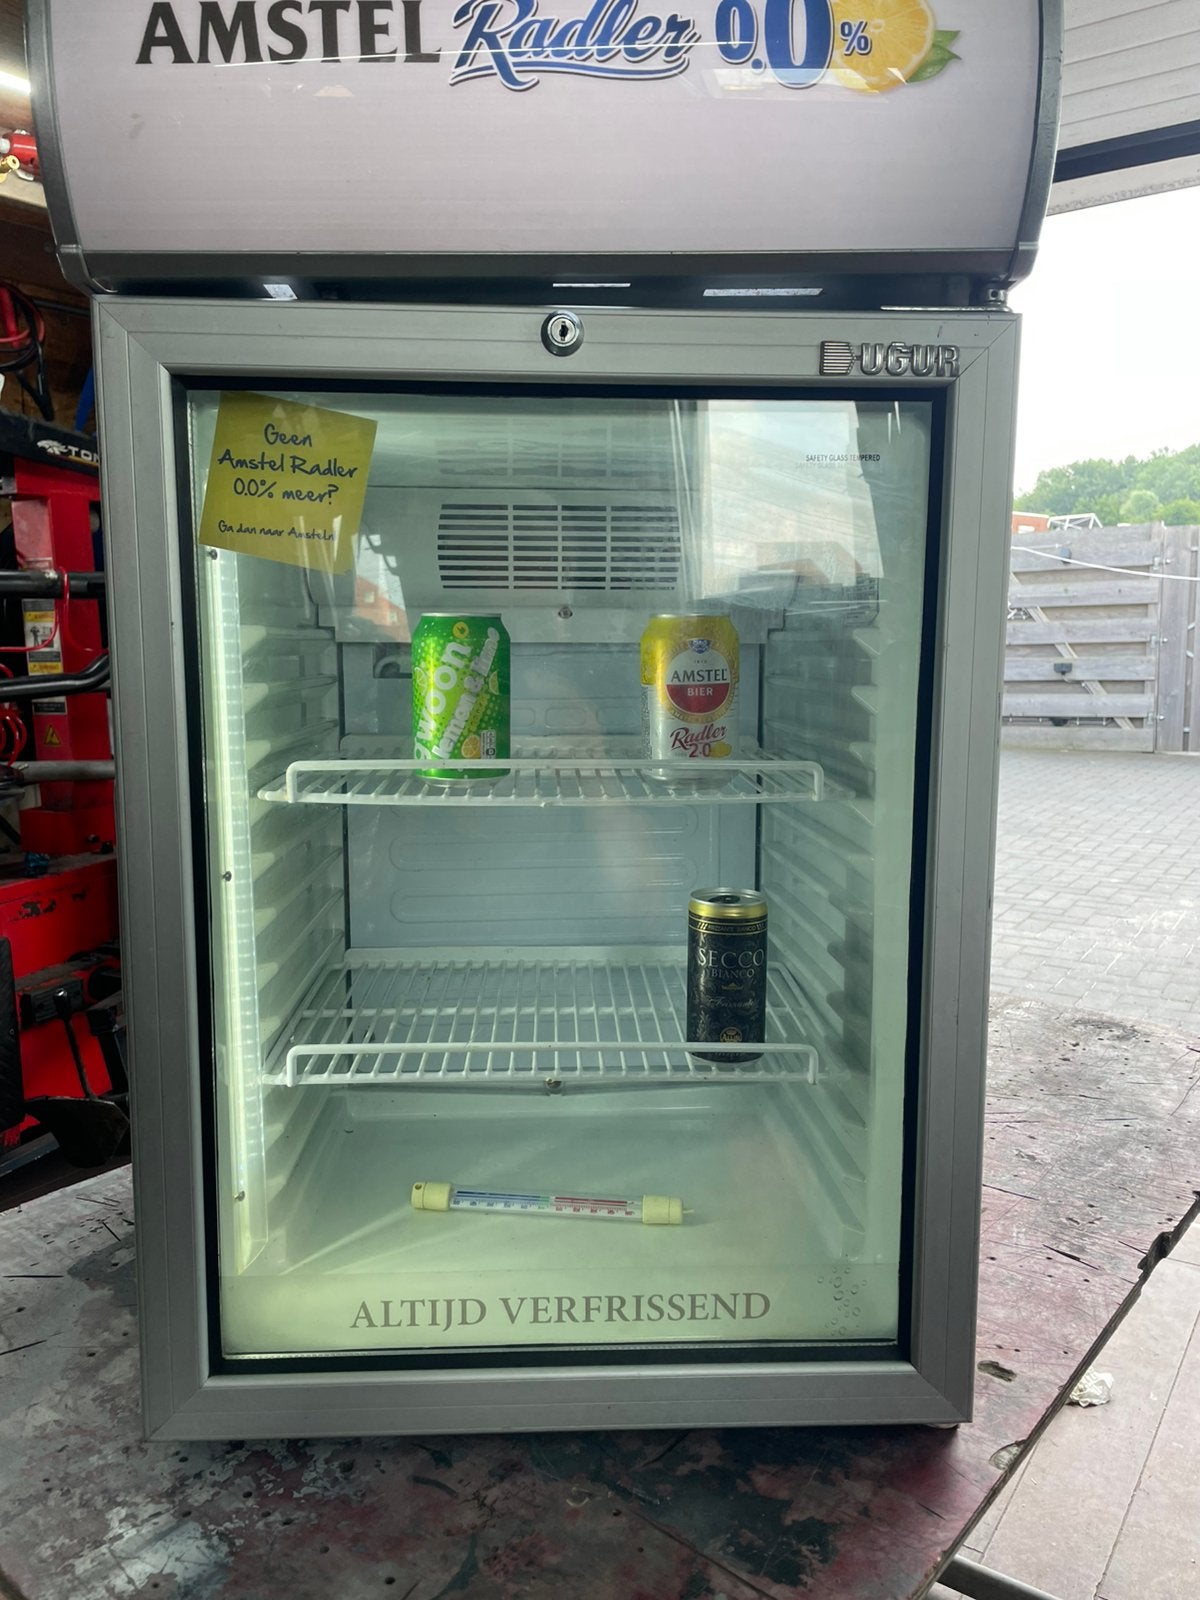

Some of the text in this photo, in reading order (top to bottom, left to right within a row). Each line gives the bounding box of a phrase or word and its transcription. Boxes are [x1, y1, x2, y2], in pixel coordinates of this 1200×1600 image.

[136, 0, 441, 65] AMSTEL
[450, 0, 697, 90] Radler
[264, 423, 313, 447] Geen
[218, 449, 358, 479] Amstel Radler
[806, 454, 881, 462] SAFETY GLASS TEMPERED
[233, 477, 339, 505] 0.0% meer?
[218, 519, 233, 534] Ga
[236, 523, 256, 535] dan
[260, 528, 285, 538] naar
[671, 668, 727, 682] AMSTEL
[687, 687, 713, 696] BIER
[431, 693, 477, 760] lemon
[669, 723, 727, 751] Radler
[698, 948, 765, 969] SECCO
[350, 1292, 771, 1333] ALTIJD VERFRISSEND
